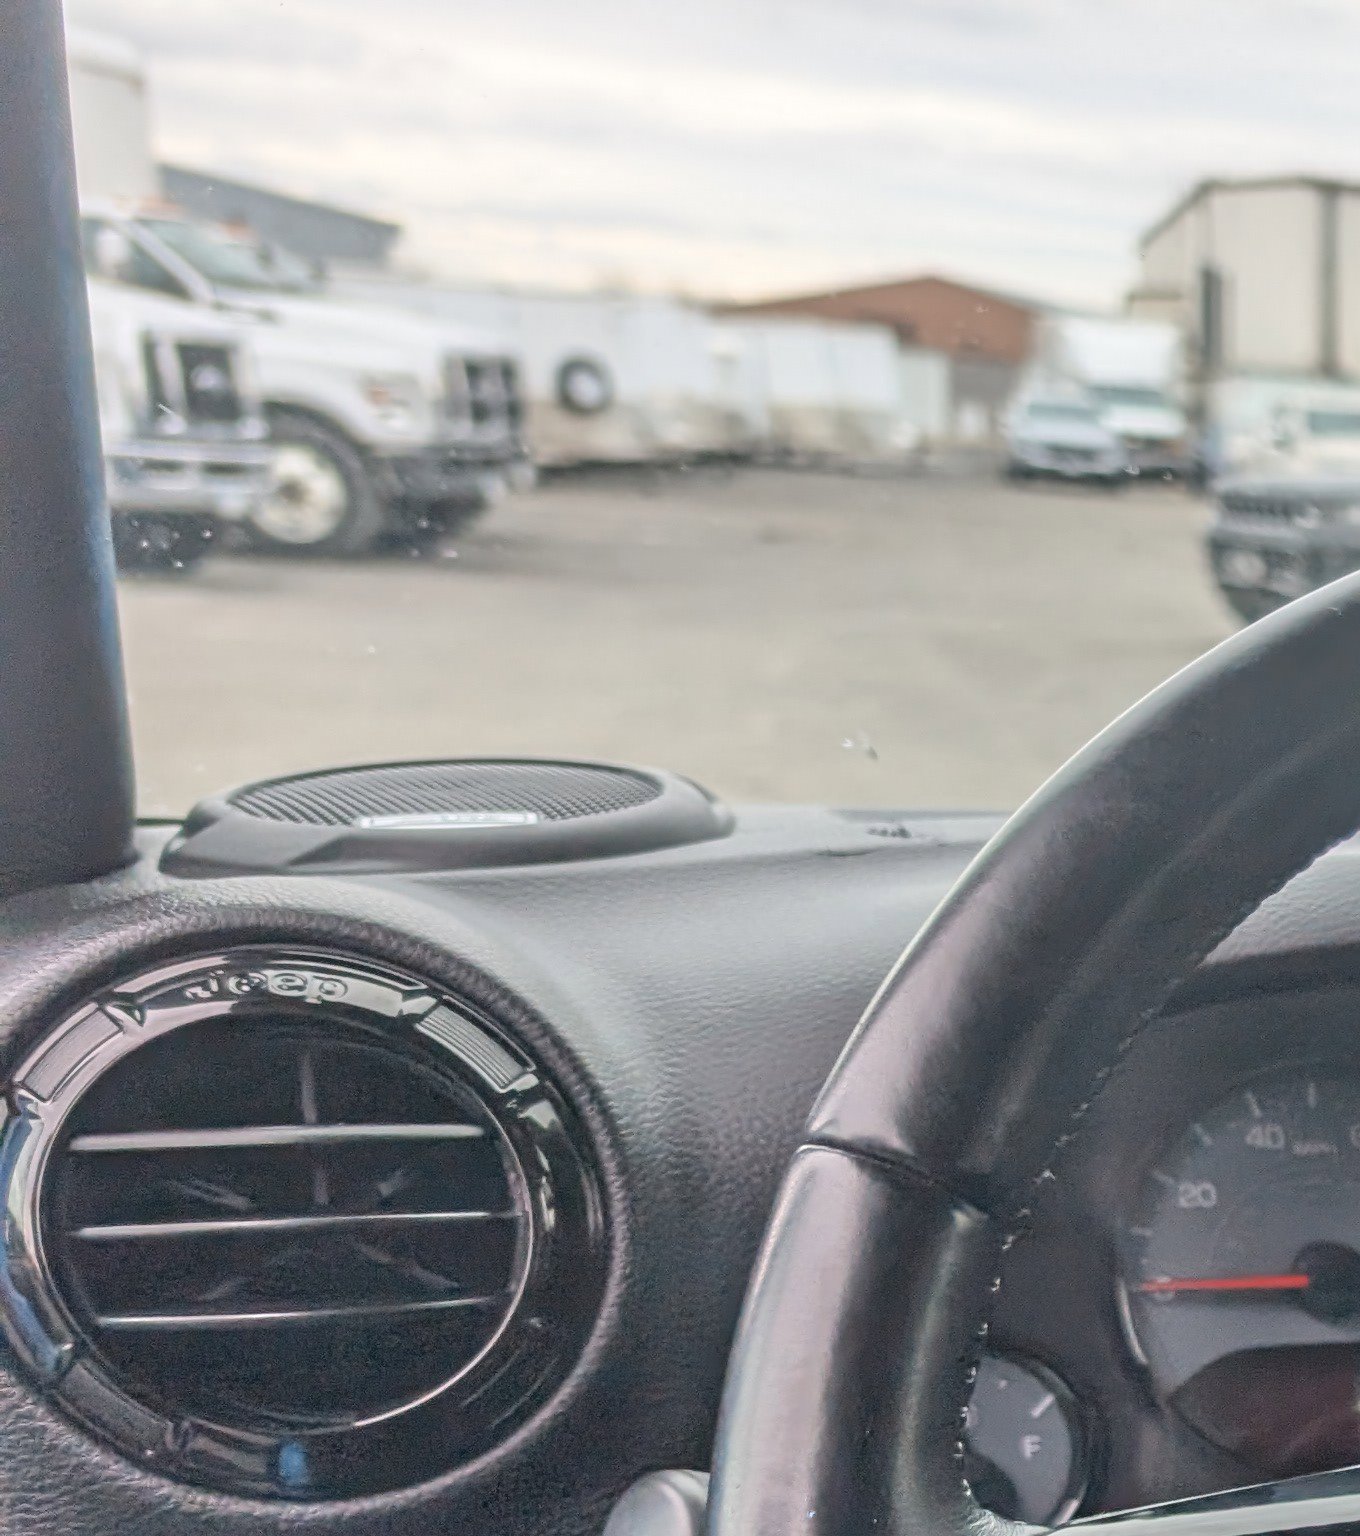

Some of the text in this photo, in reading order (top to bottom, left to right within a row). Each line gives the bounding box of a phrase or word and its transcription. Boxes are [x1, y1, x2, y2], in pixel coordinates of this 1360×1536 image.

[183, 968, 348, 1005] Jeep
[1245, 1123, 1285, 1150] 40
[1178, 1181, 1217, 1208] 20
[1023, 1436, 1042, 1459] F
